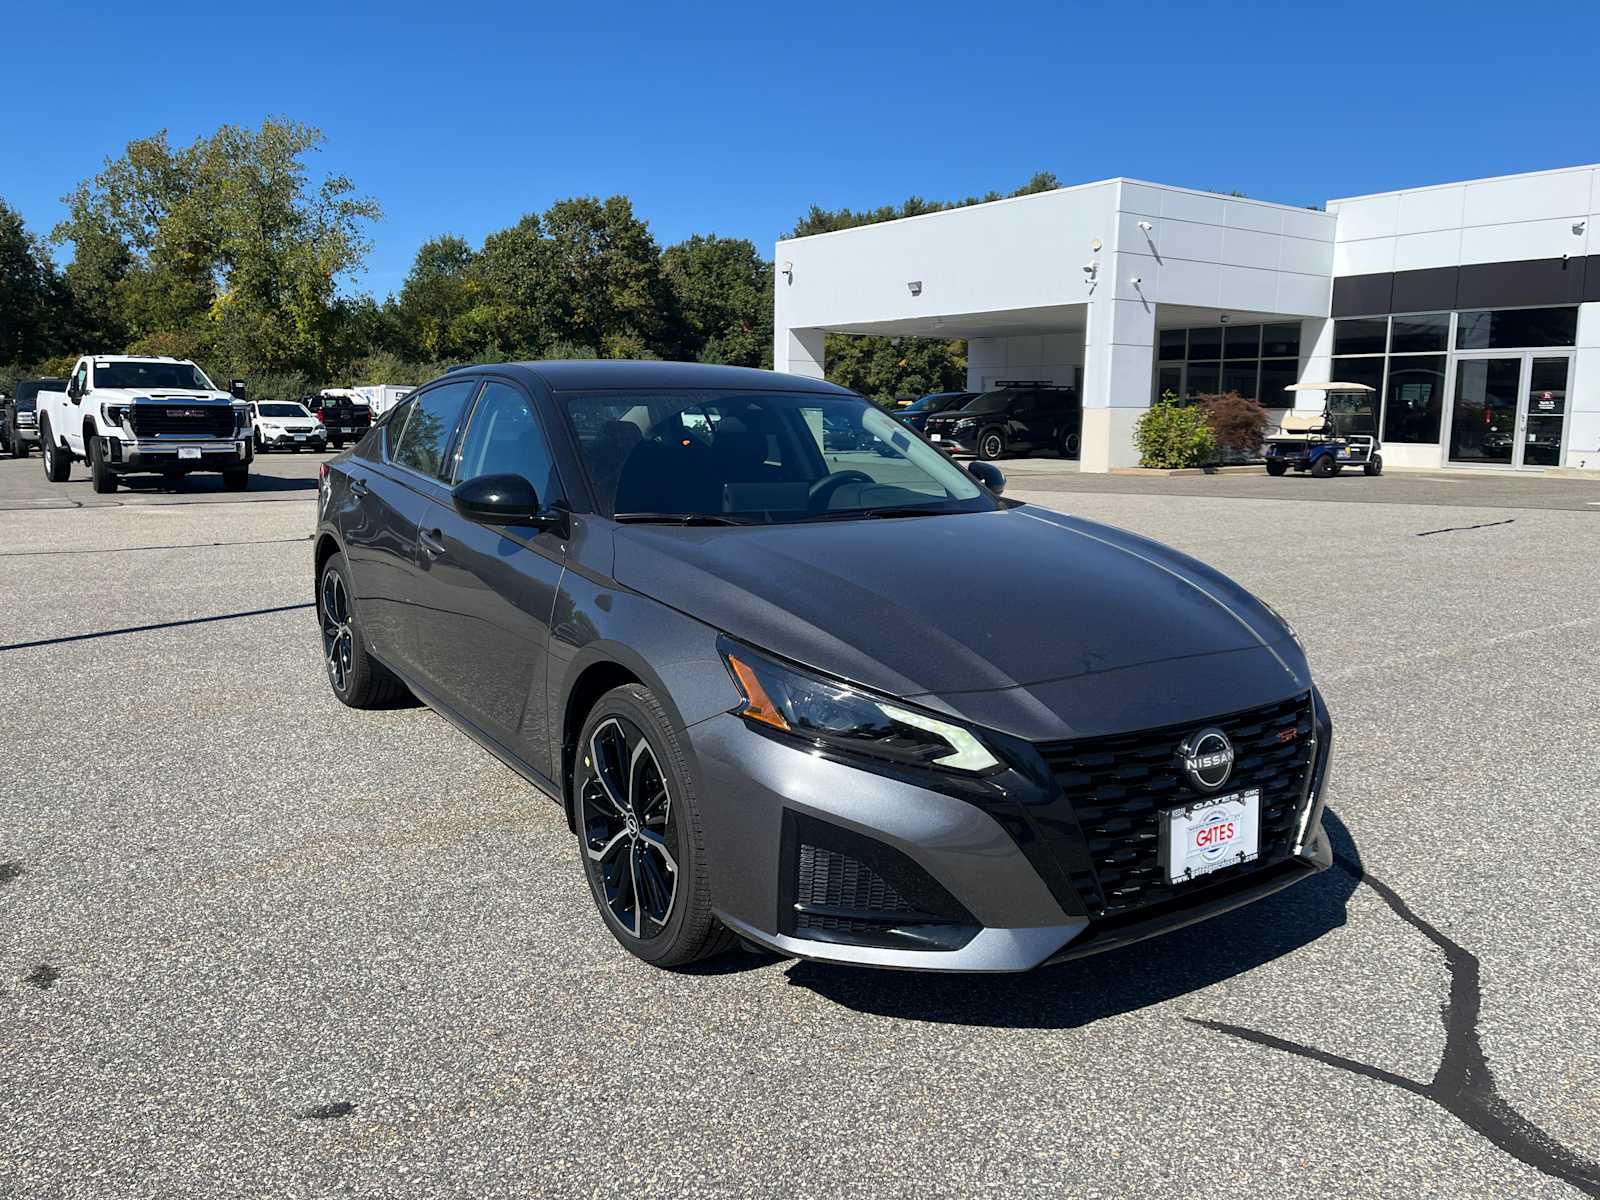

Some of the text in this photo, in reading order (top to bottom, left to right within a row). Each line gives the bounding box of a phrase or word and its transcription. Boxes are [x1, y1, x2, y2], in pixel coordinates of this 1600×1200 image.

[1186, 748, 1234, 770] NISSAN
[1193, 788, 1260, 810] GATES GMC
[1196, 822, 1234, 847] GATES
